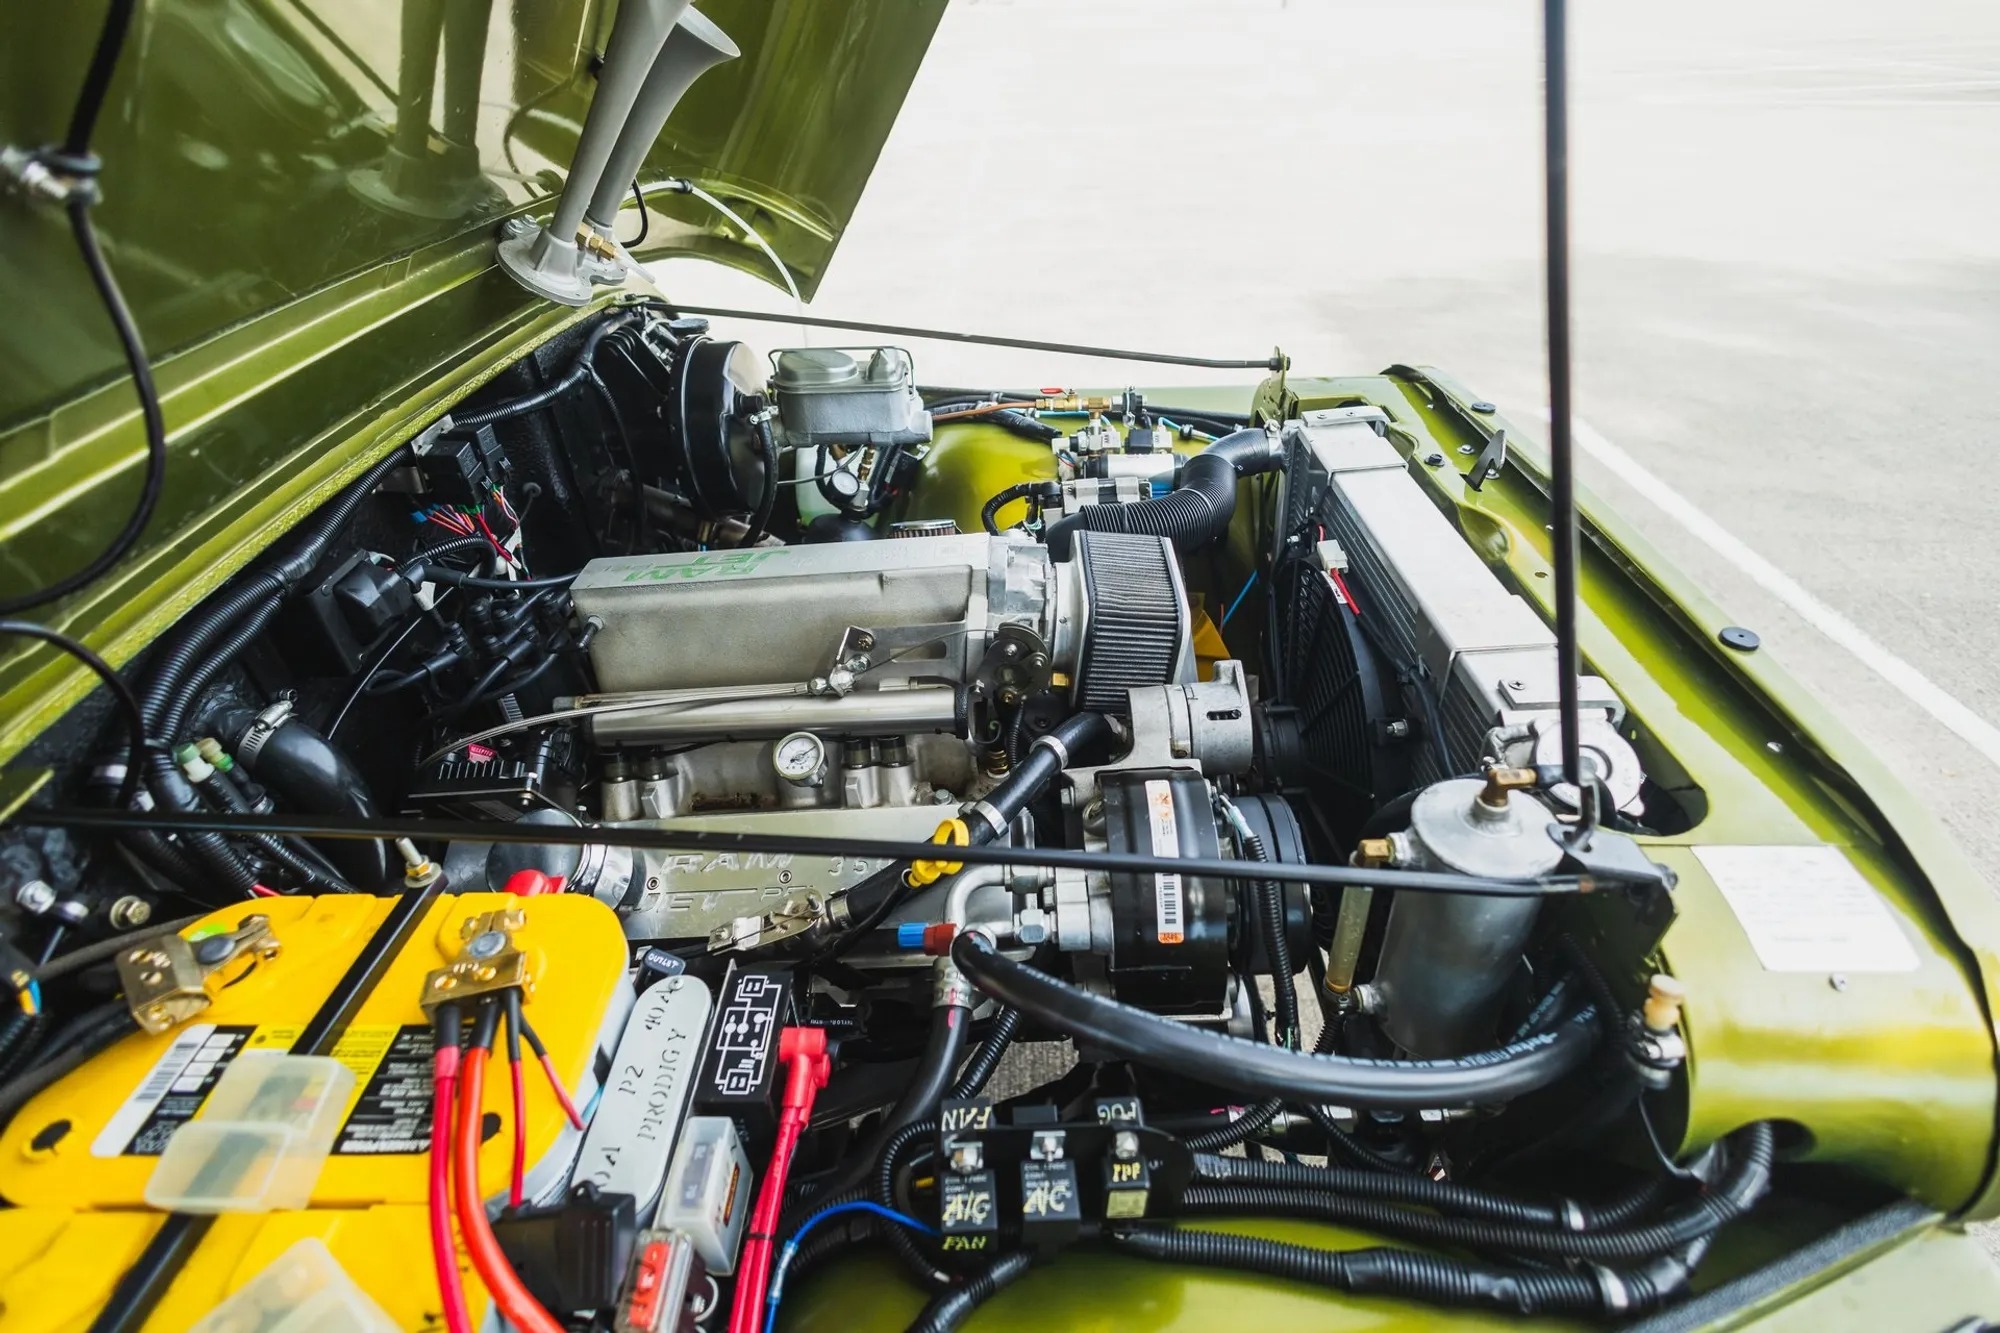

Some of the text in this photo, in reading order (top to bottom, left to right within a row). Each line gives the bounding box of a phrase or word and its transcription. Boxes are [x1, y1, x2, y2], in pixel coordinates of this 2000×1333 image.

[658, 852, 795, 876] RAM
[632, 889, 724, 914] JET
[647, 953, 679, 969] OUTLET
[619, 1064, 644, 1096] P2
[637, 1028, 687, 1141] PRODIGY
[941, 1106, 991, 1132] FAN
[942, 1189, 990, 1221] A/C
[942, 1235, 987, 1251] FAN
